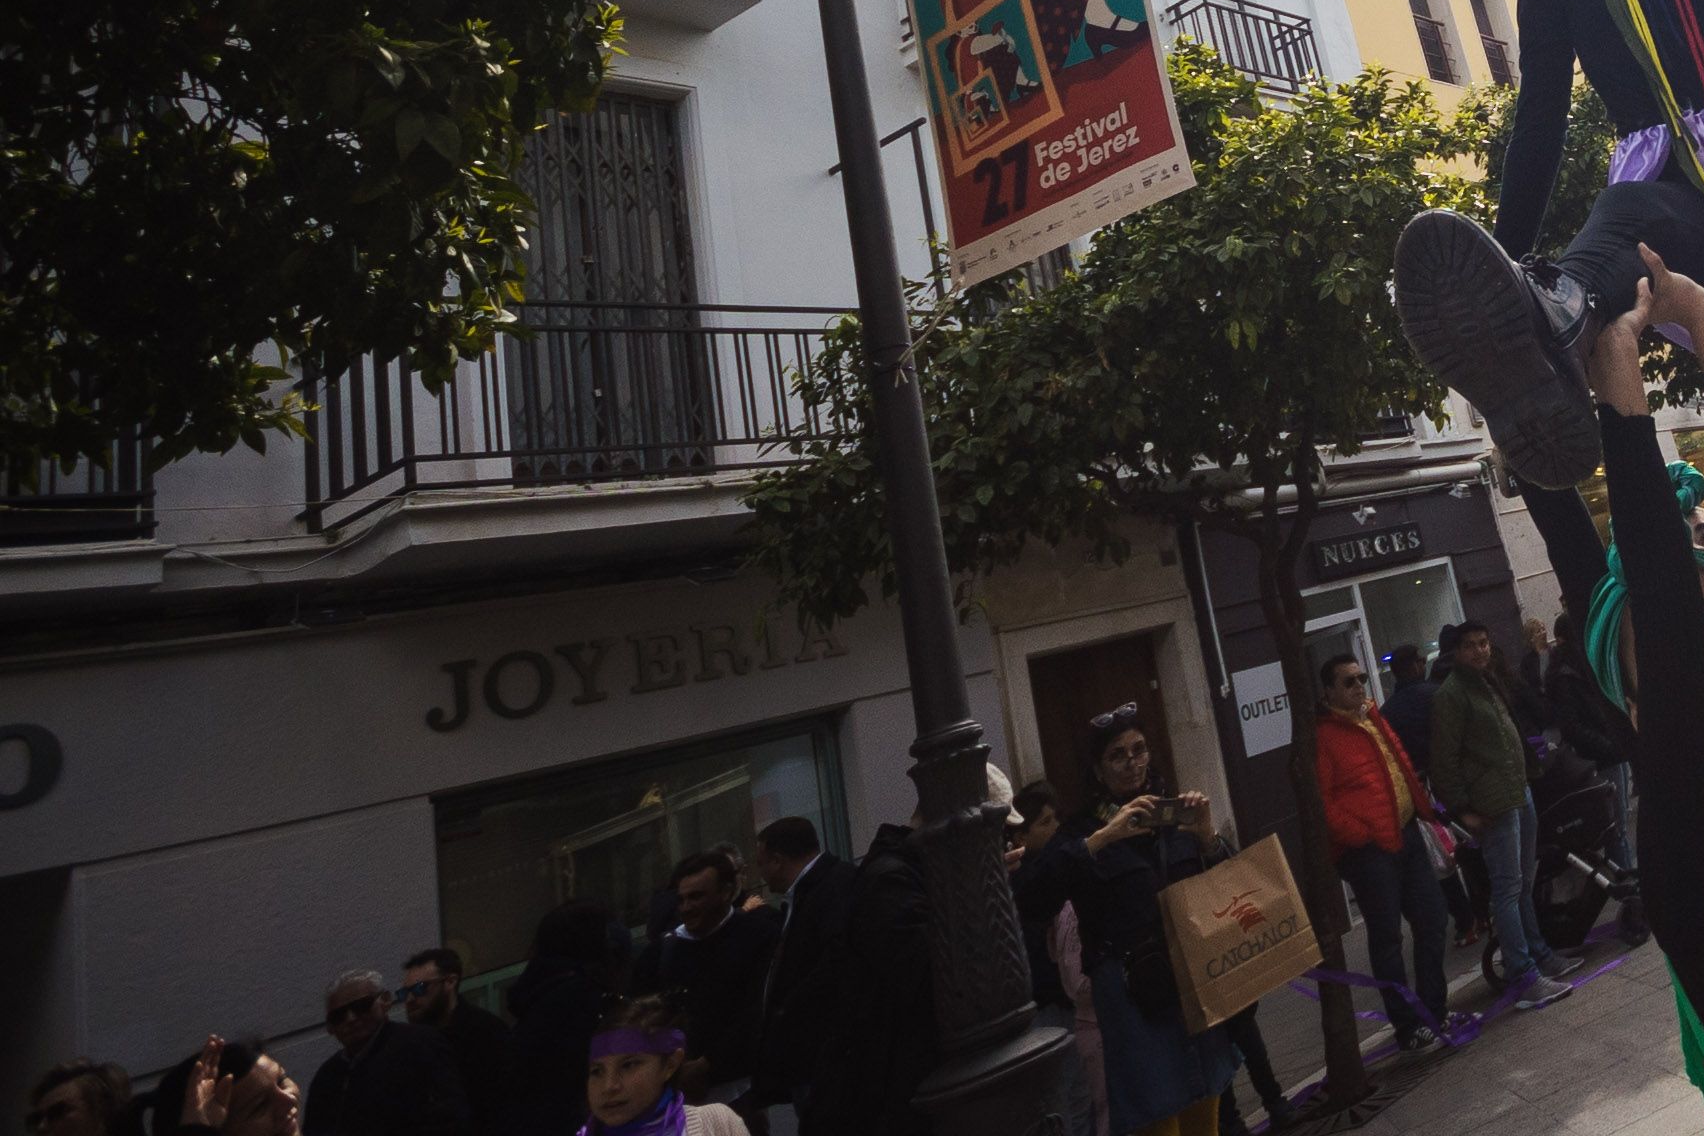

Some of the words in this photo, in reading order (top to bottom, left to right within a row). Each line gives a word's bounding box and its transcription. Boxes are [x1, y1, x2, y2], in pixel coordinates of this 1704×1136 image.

[1034, 102, 1128, 167] Festival
[1039, 161, 1072, 189] de
[1075, 125, 1141, 174] Jerez
[973, 140, 1030, 227] 27
[1320, 529, 1422, 568] NUECES
[1240, 694, 1290, 722] OUTLET
